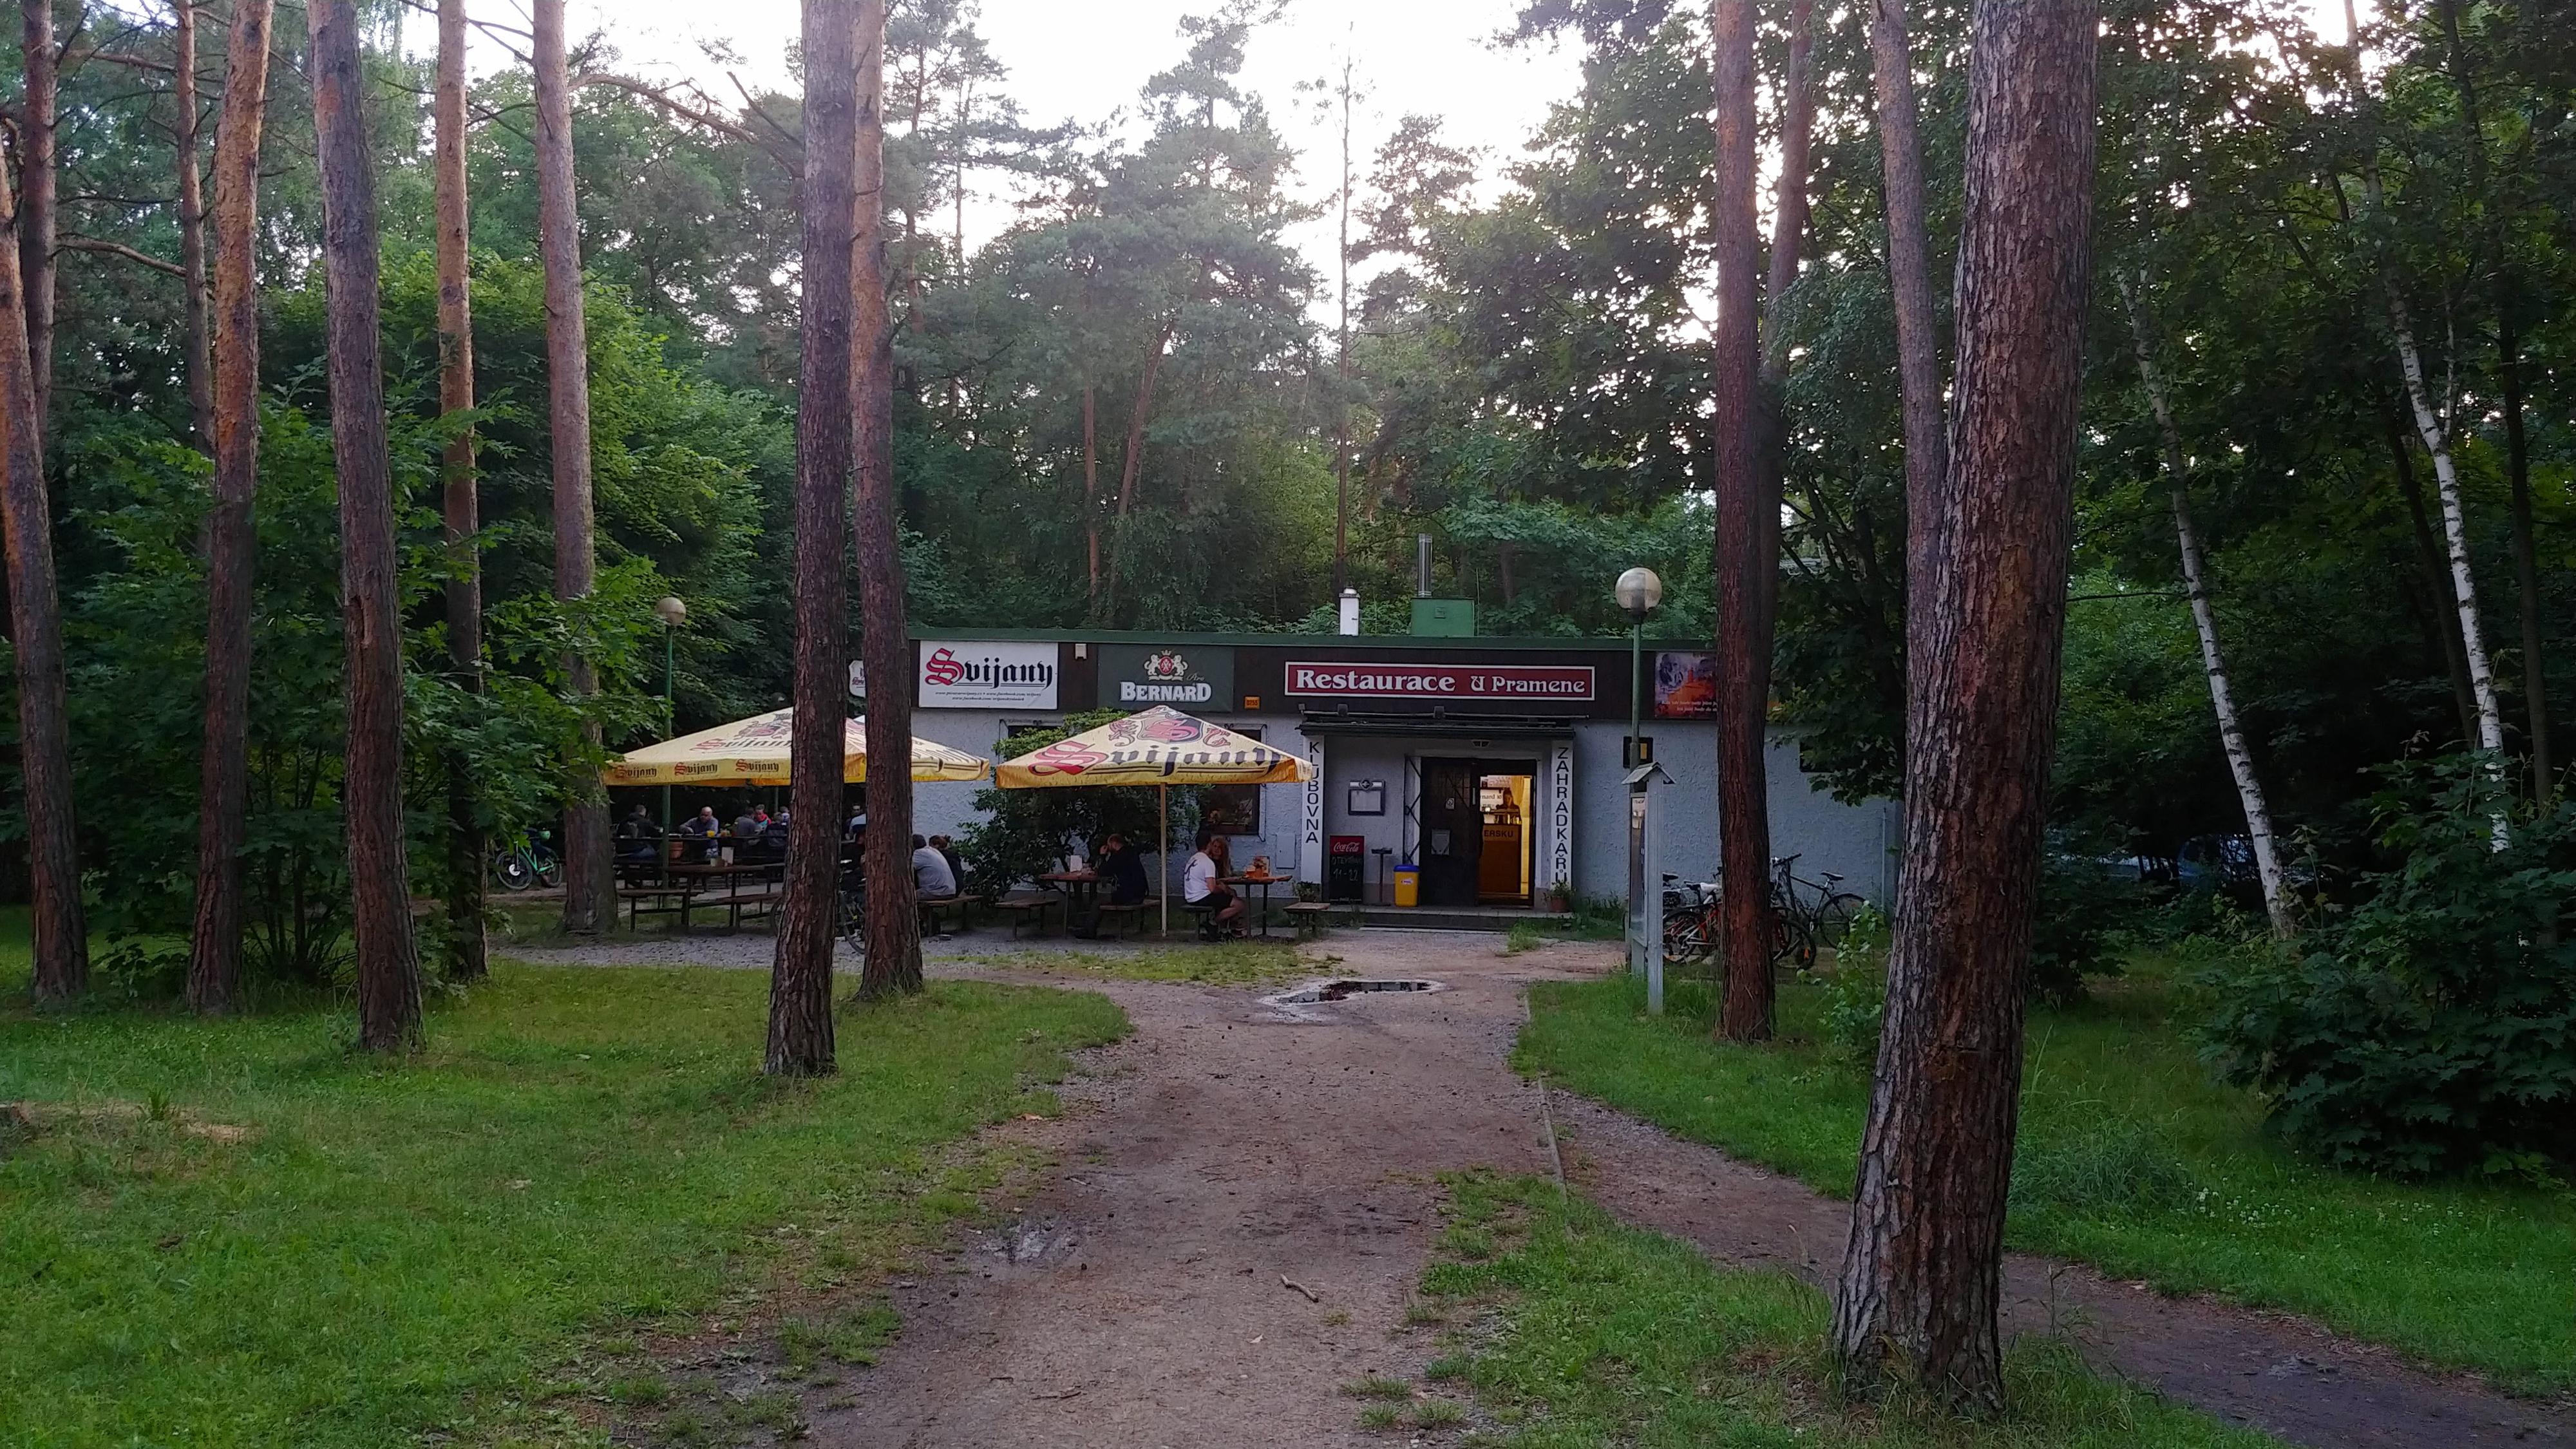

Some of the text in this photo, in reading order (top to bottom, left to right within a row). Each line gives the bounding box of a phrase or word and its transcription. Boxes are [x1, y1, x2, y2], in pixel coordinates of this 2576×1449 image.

[925, 648, 1053, 690] Svijany
[1120, 681, 1212, 702] BERNARD
[1296, 669, 1455, 692] Restaurace
[1492, 676, 1586, 694] Pramene
[675, 762, 718, 775] Svijany
[735, 759, 779, 772] Svijany
[1028, 741, 1282, 777] Svijany
